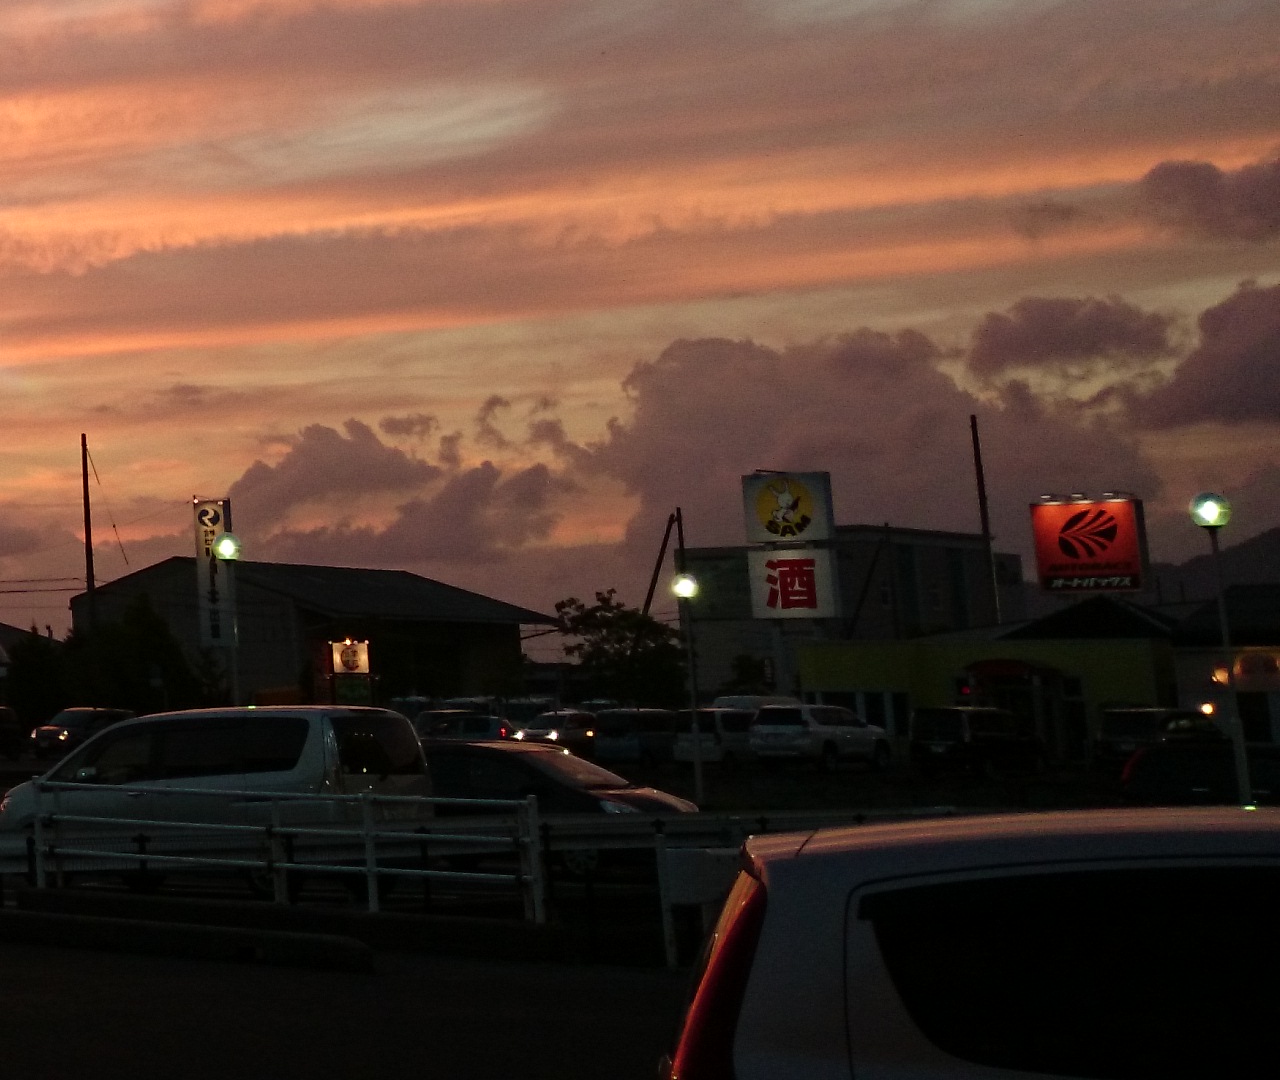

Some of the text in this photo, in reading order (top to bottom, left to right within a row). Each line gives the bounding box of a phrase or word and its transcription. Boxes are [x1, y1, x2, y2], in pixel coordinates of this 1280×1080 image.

[765, 514, 811, 537] SAM
[765, 558, 817, 609] 酒
[1051, 576, 1132, 588] オートバックス
